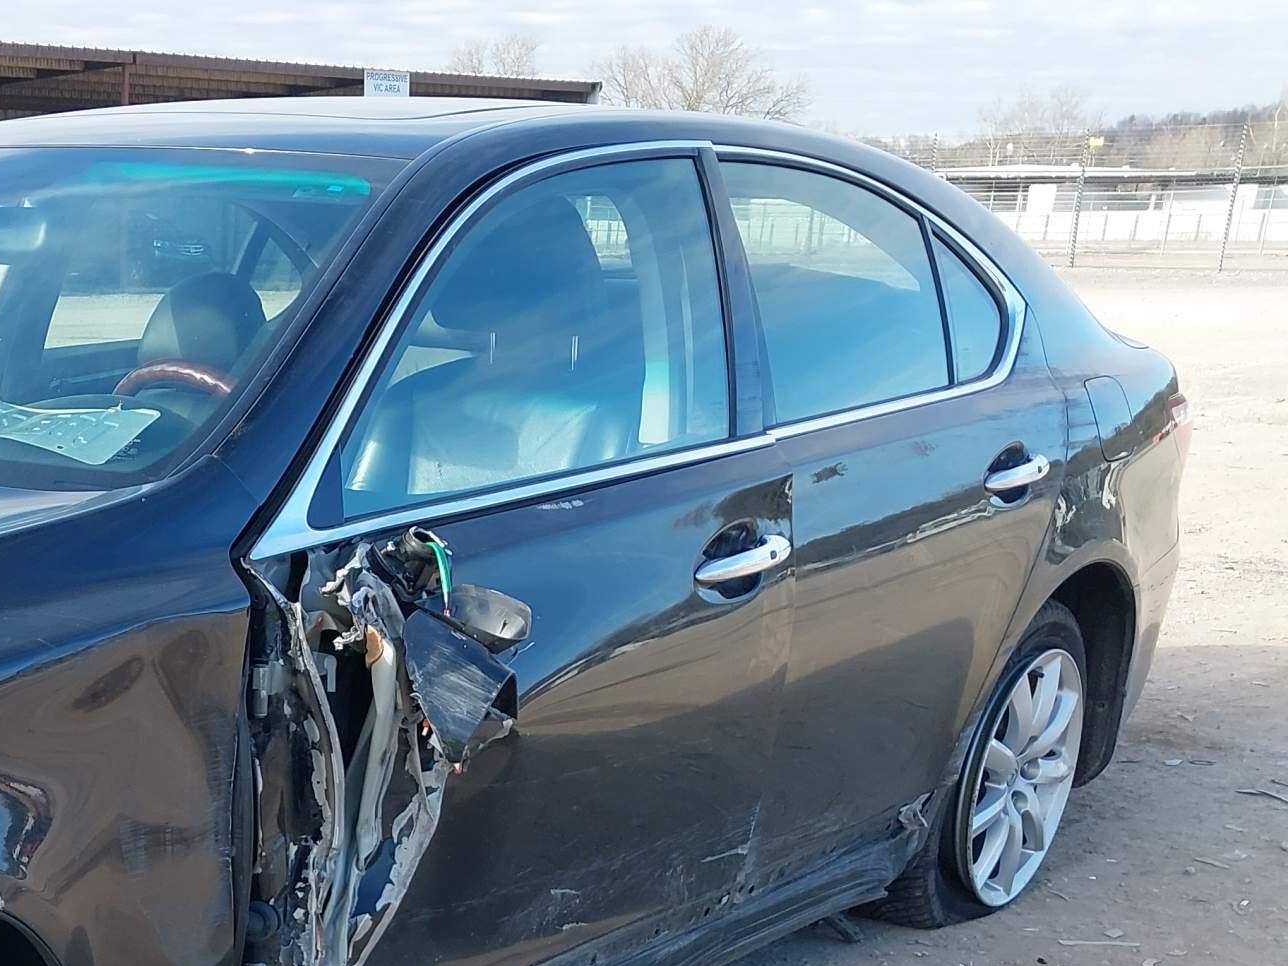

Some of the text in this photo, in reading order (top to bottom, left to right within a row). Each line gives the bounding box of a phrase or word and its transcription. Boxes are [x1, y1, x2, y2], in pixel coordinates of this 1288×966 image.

[366, 71, 409, 83] PROGRESSIVE
[373, 83, 401, 93] VIC AREA
